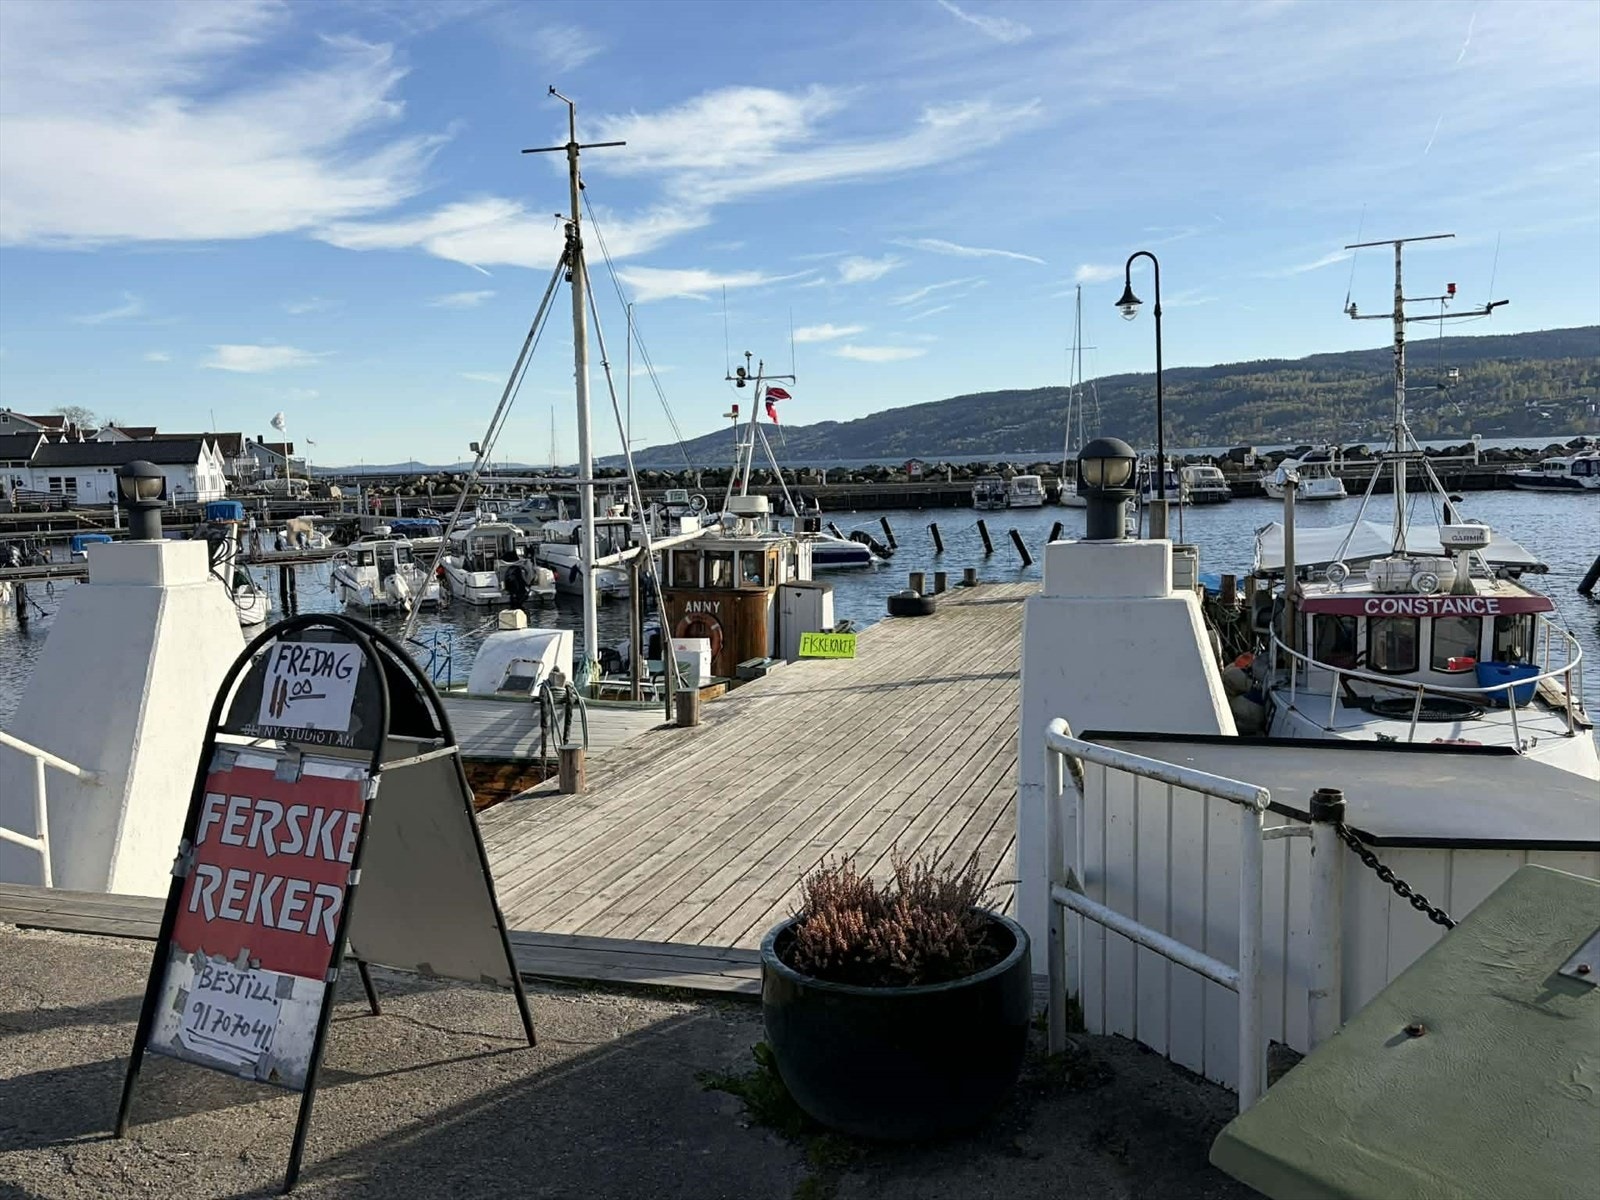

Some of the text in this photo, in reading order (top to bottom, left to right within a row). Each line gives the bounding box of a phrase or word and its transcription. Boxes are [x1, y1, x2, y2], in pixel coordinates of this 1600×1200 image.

[685, 601, 720, 613] ANNY
[1365, 598, 1501, 614] CONSTANCE
[264, 726, 280, 737] NY
[328, 732, 333, 744] I
[196, 792, 362, 863] FERSKE
[188, 863, 344, 945] REKER
